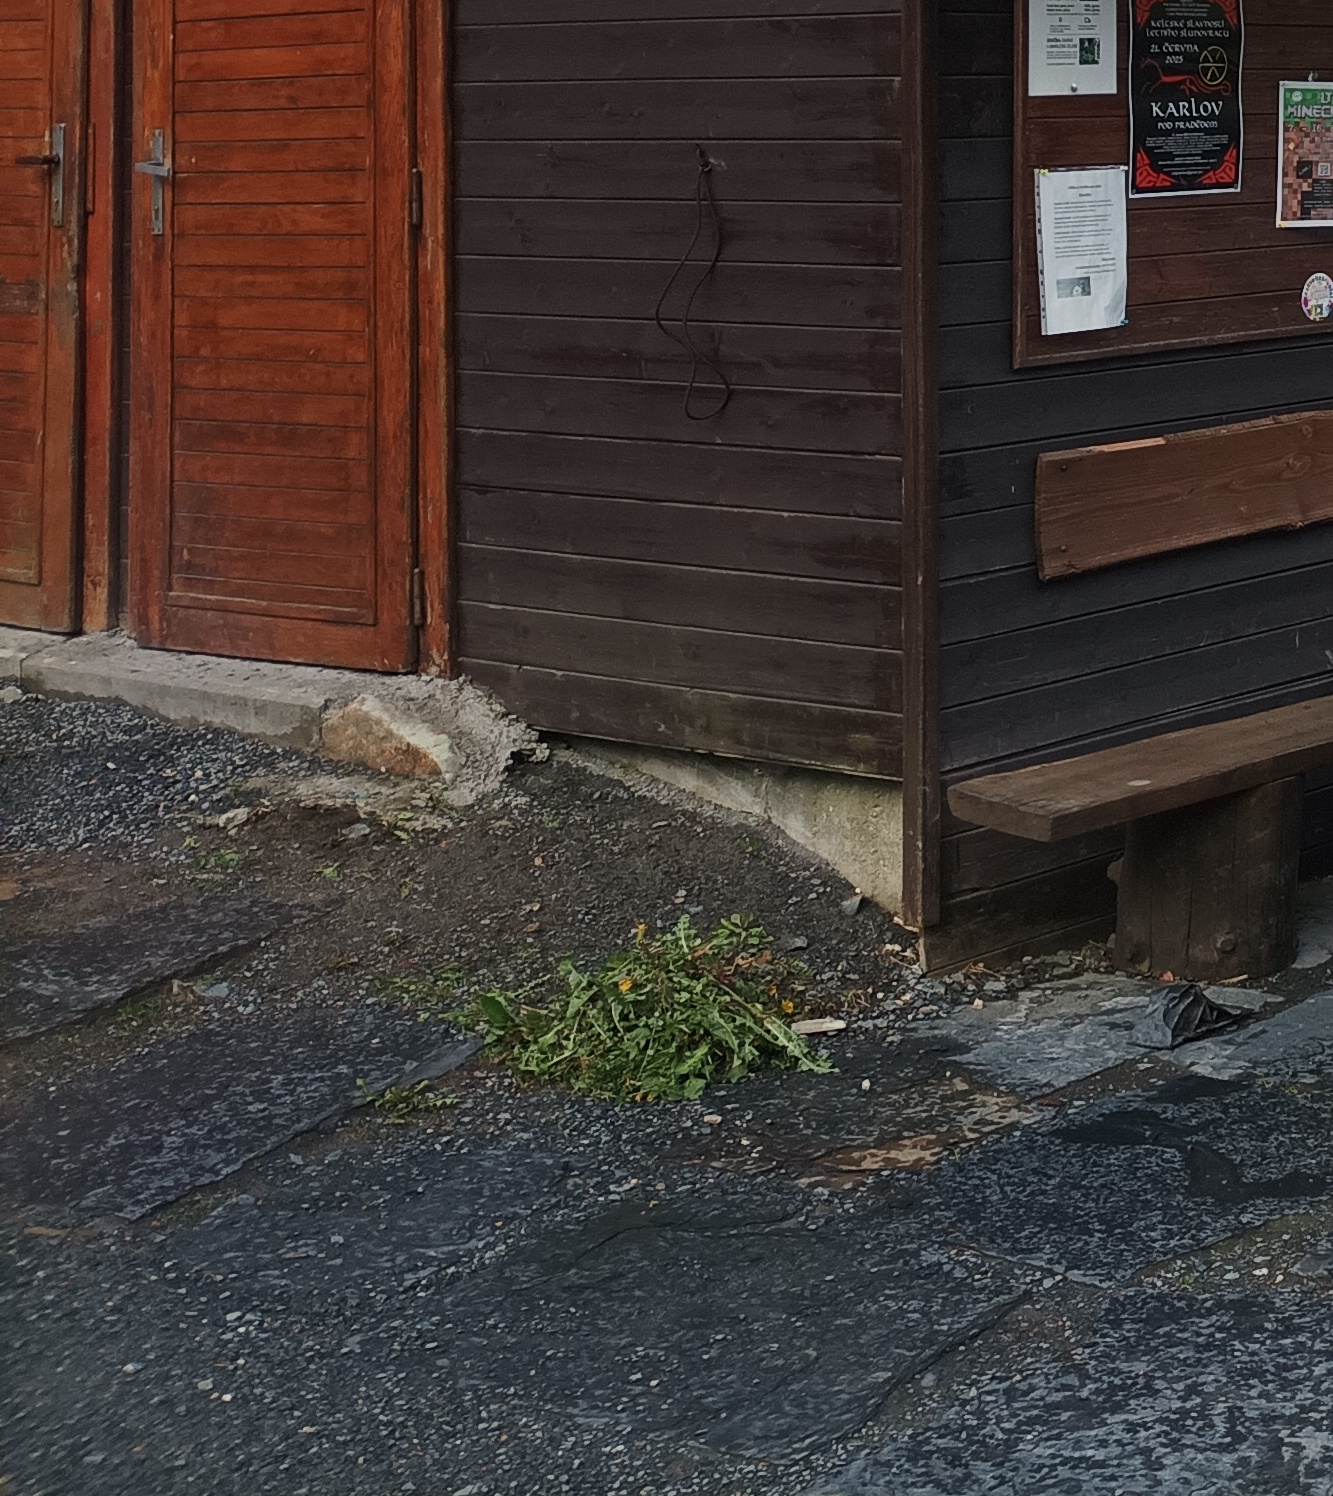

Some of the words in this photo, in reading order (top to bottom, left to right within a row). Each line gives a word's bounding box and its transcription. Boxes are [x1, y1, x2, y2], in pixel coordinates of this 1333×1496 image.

[1165, 55, 1183, 63] 2025
[1151, 98, 1223, 119] KARLOV
[1158, 121, 1173, 129] POD
